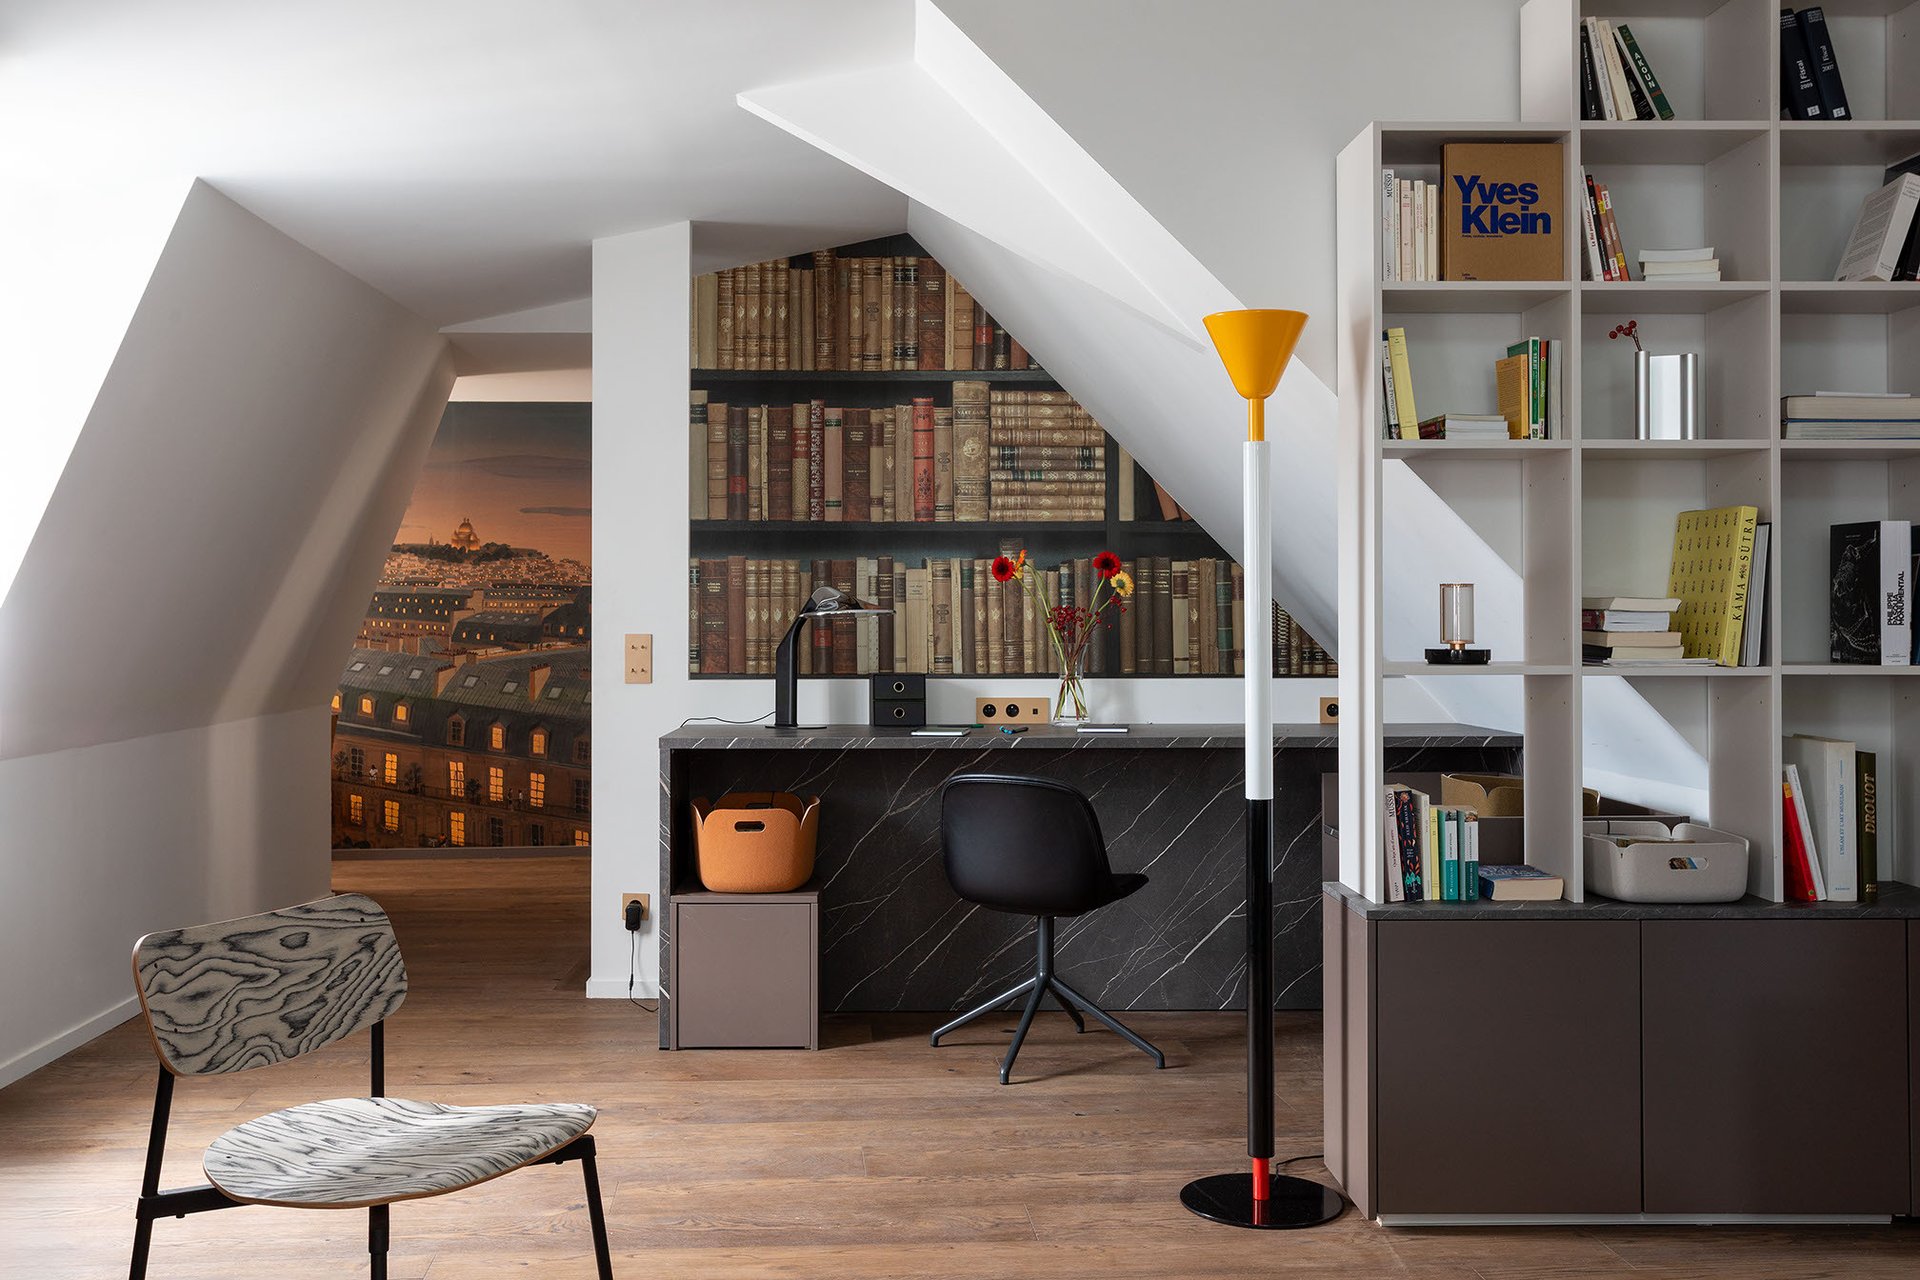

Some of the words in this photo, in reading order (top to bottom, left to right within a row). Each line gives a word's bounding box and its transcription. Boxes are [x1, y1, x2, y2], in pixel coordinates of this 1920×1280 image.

[1820, 45, 1829, 61] Fiscal
[1796, 60, 1807, 80] Fiscal
[1453, 175, 1538, 204] Yves
[1462, 205, 1551, 234] Klein
[1386, 793, 1395, 818] MUSSO
[1864, 773, 1875, 834] DROUOT
